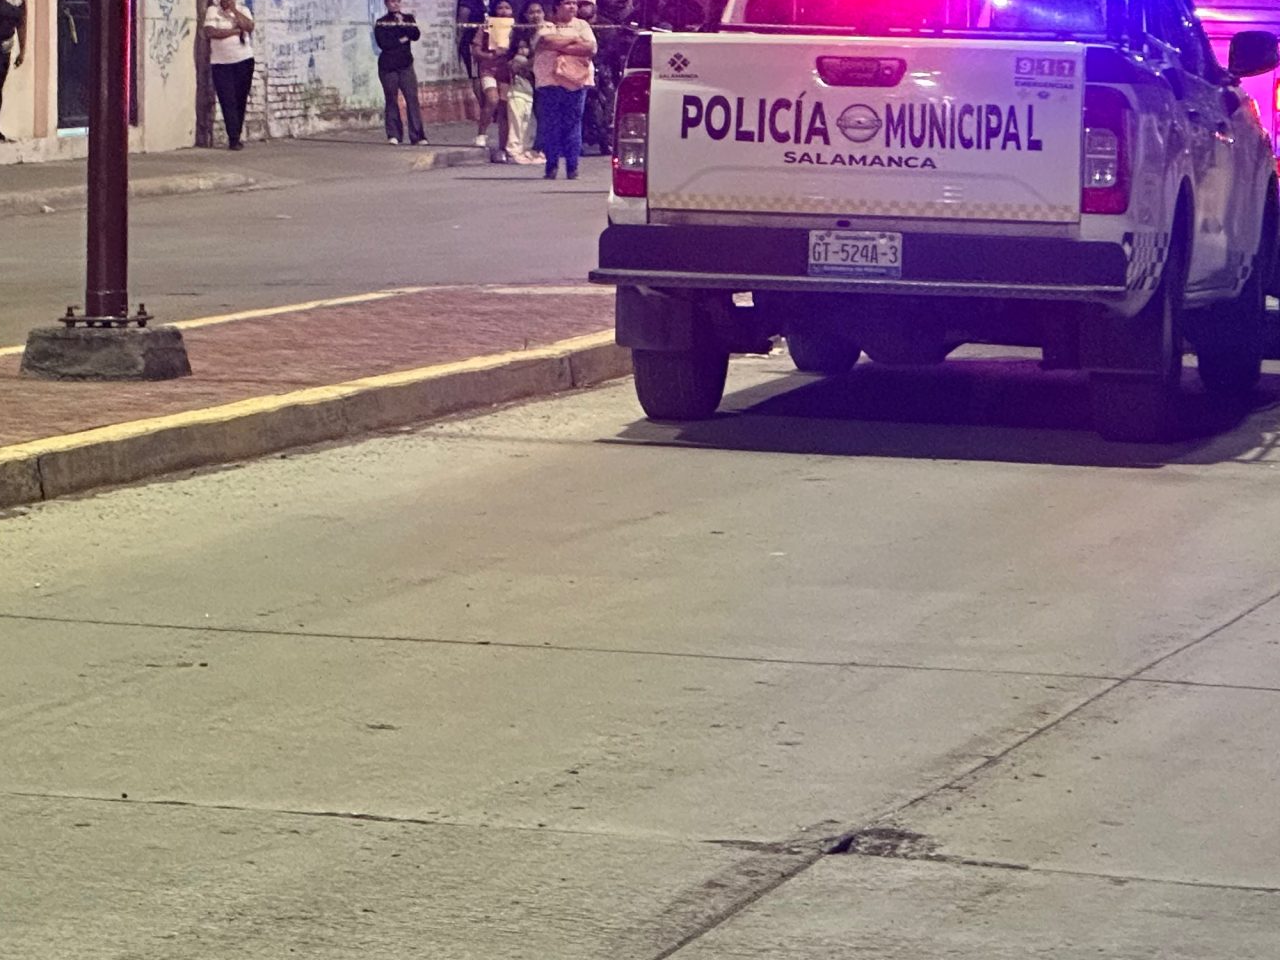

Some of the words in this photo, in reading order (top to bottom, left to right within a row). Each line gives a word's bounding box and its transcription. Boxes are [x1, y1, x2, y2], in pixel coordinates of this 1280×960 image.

[1018, 58, 1072, 76] 911
[681, 91, 831, 146] POLICÍA
[885, 103, 1043, 151] MUNICIPAL
[783, 151, 937, 169] SALAMANCA
[812, 242, 898, 264] GT-524A-3
